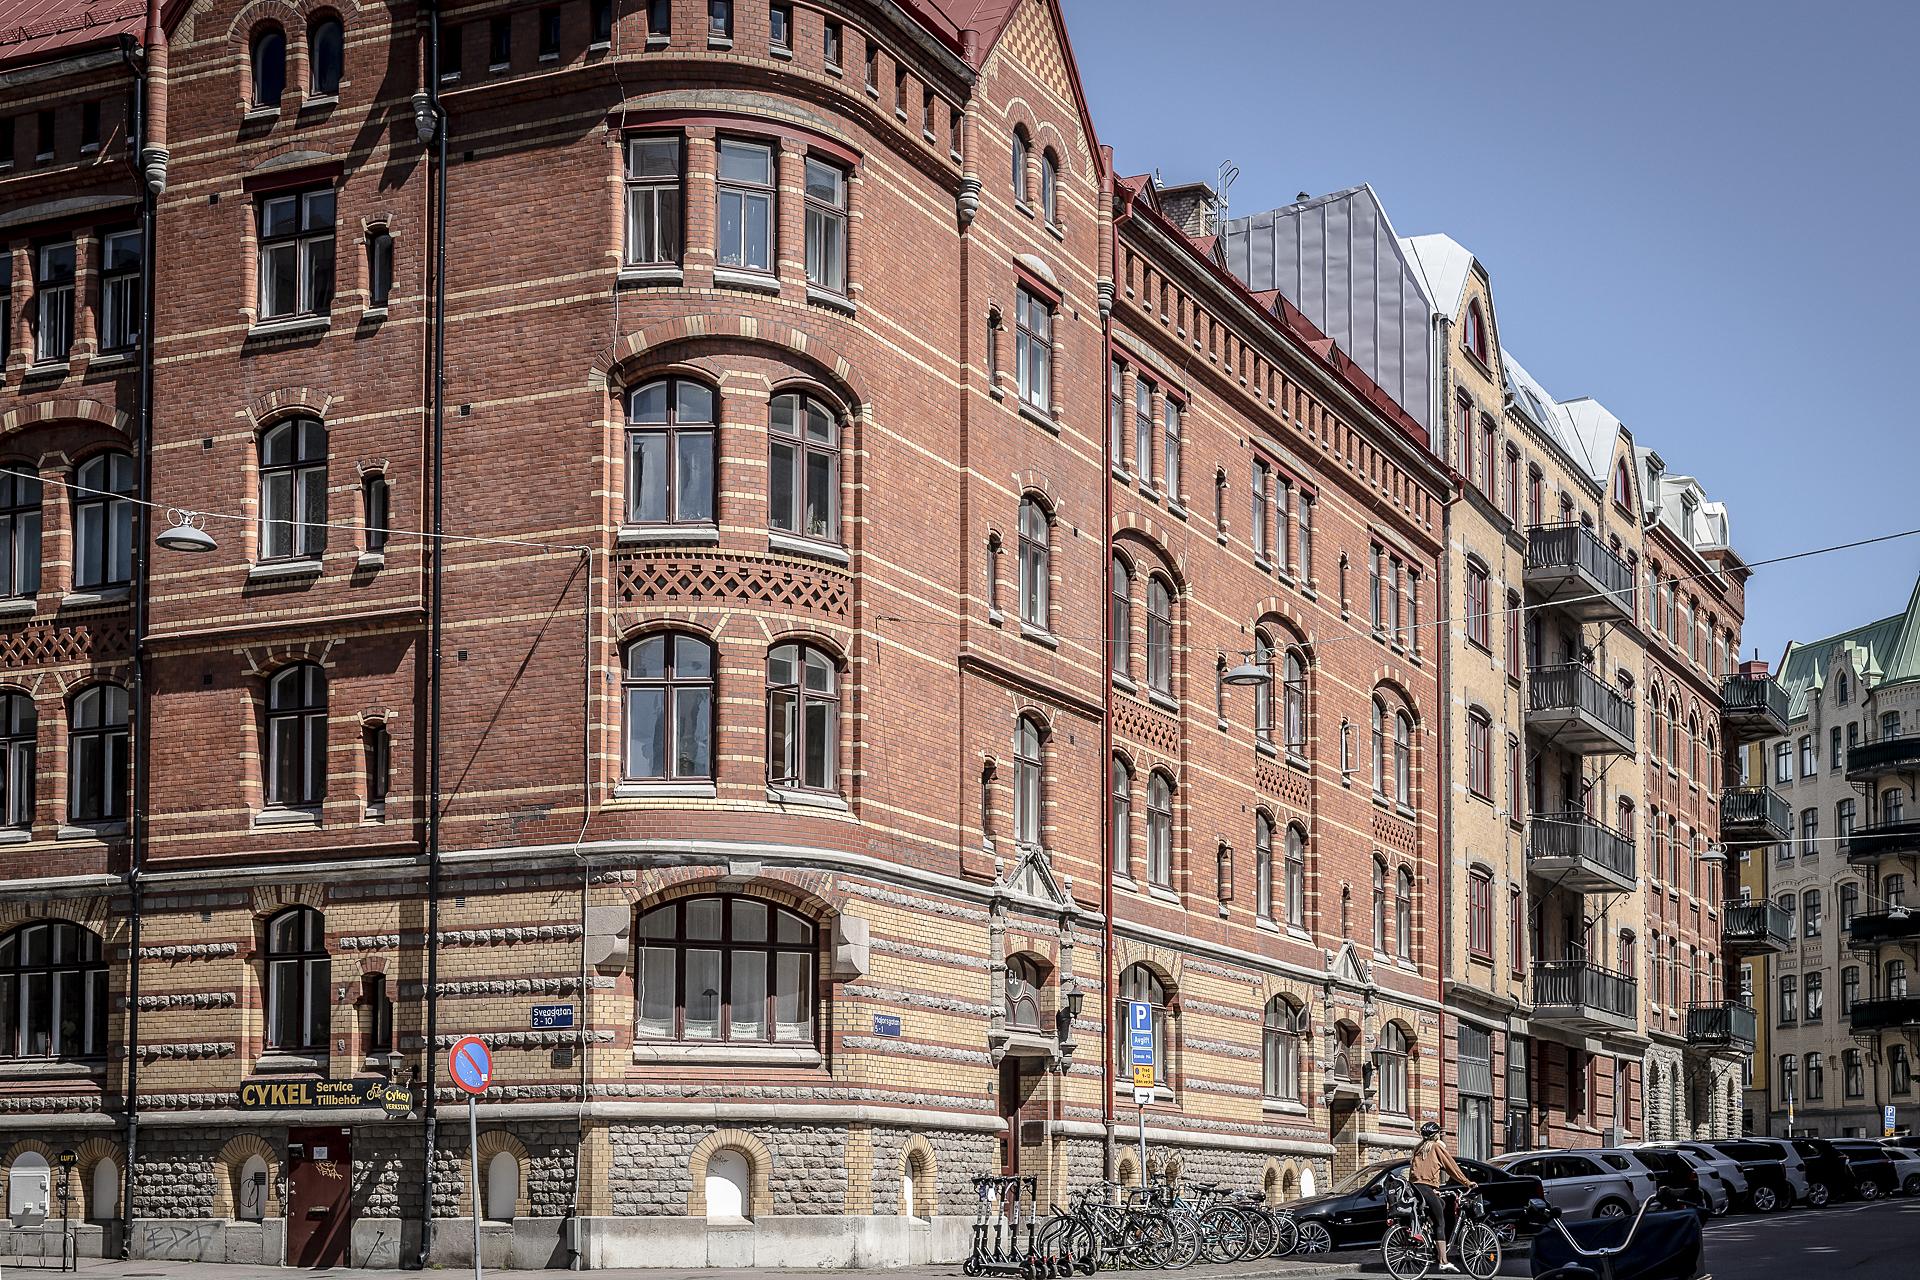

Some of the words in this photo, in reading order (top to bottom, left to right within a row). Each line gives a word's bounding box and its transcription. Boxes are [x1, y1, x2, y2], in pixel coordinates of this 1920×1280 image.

[533, 1008, 572, 1016] Sveagatan
[1136, 1005, 1146, 1028] P
[243, 1084, 312, 1105] CYKEL
[316, 1081, 353, 1092] Service
[385, 1089, 410, 1102] Cykel
[316, 1094, 361, 1105] Tillbehör
[1888, 1107, 1893, 1115] P
[60, 1154, 74, 1162] LUFT
